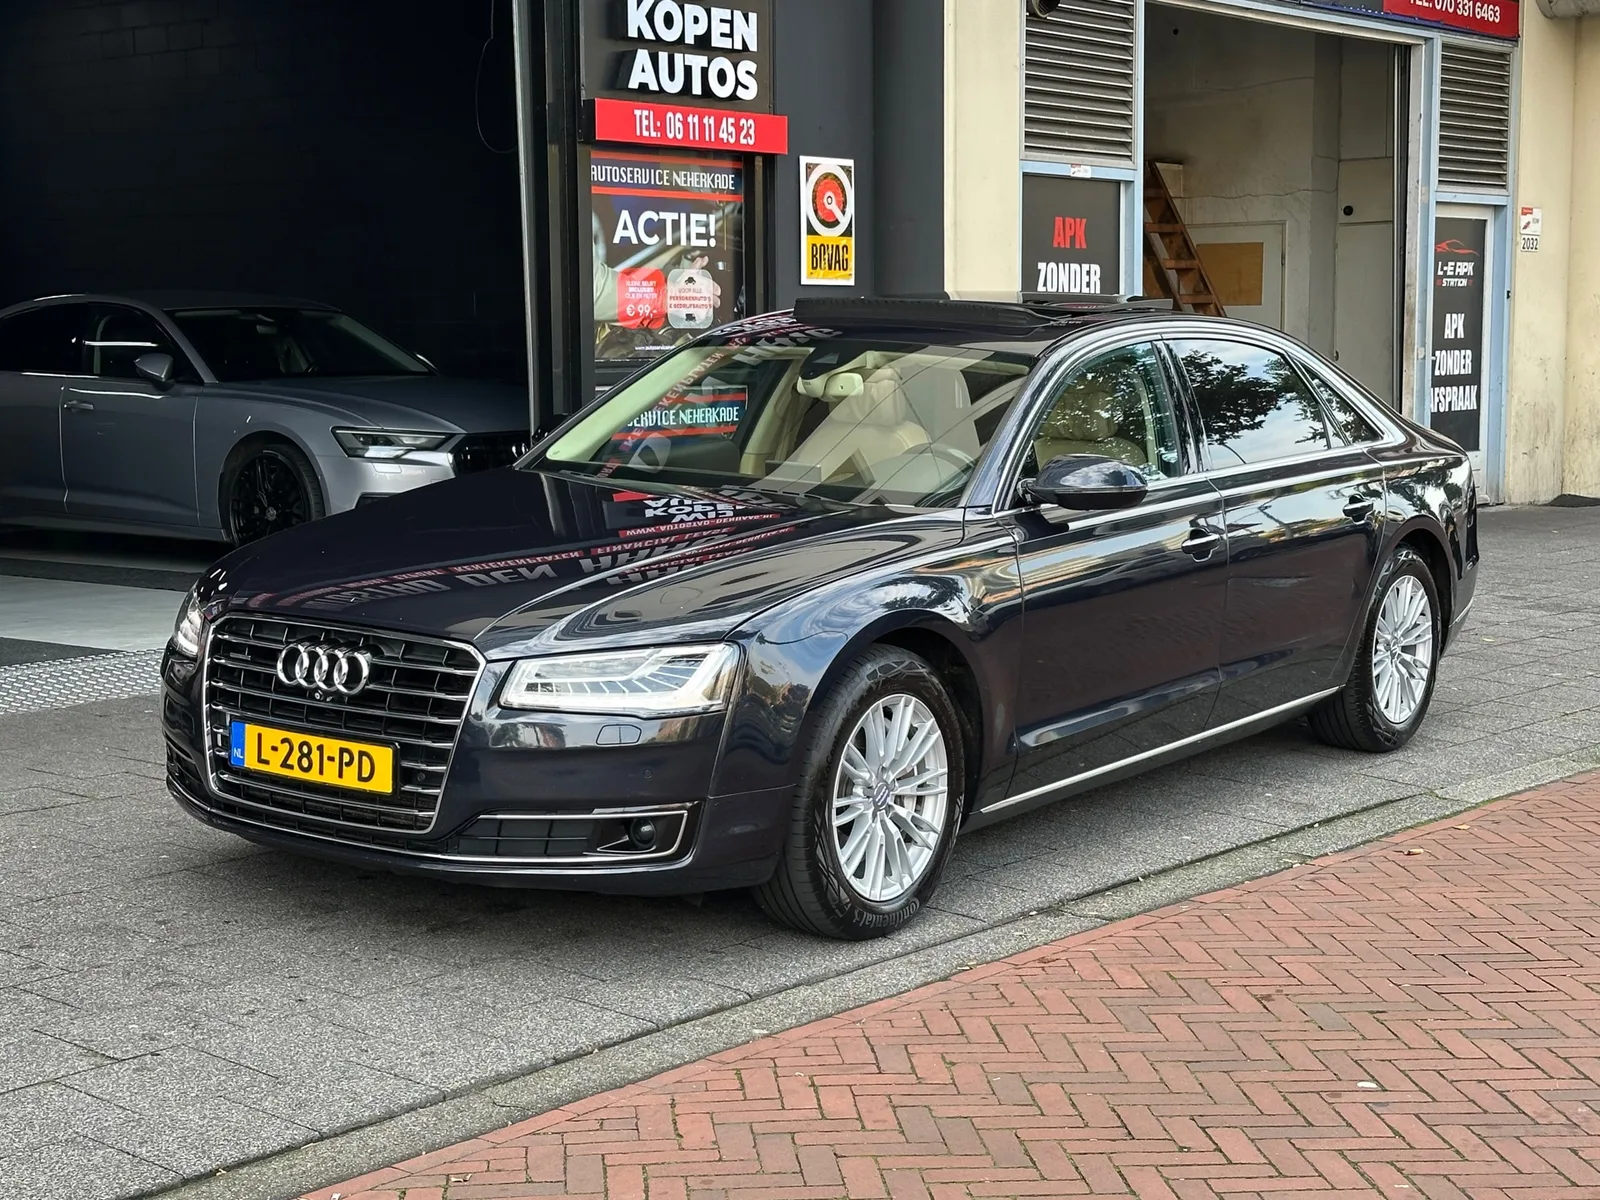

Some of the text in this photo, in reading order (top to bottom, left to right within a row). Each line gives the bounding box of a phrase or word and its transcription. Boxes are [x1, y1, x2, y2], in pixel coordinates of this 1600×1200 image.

[1457, 0, 1473, 18] 331
[1475, 3, 1500, 23] 6463
[627, 0, 758, 52] KOPEN
[628, 48, 758, 100] AUTOS
[634, 109, 755, 145] TEL: 06 11 11 45 23
[591, 164, 735, 190] AUTOSERVICE NEHERKADE
[613, 209, 716, 248] ACTIE!
[1053, 217, 1087, 249] APK
[811, 243, 848, 271] BOVAG
[1522, 237, 1538, 251] 2032
[1037, 262, 1100, 294] ZONDER
[1455, 261, 1474, 276] APK
[1442, 278, 1467, 287] STATION
[1444, 313, 1465, 339] APK
[1435, 350, 1472, 376] ZONDER
[679, 407, 739, 425] NEHERKADE
[233, 747, 243, 758] NL
[257, 732, 376, 783] L-281-PD
[860, 897, 920, 928] Continental
